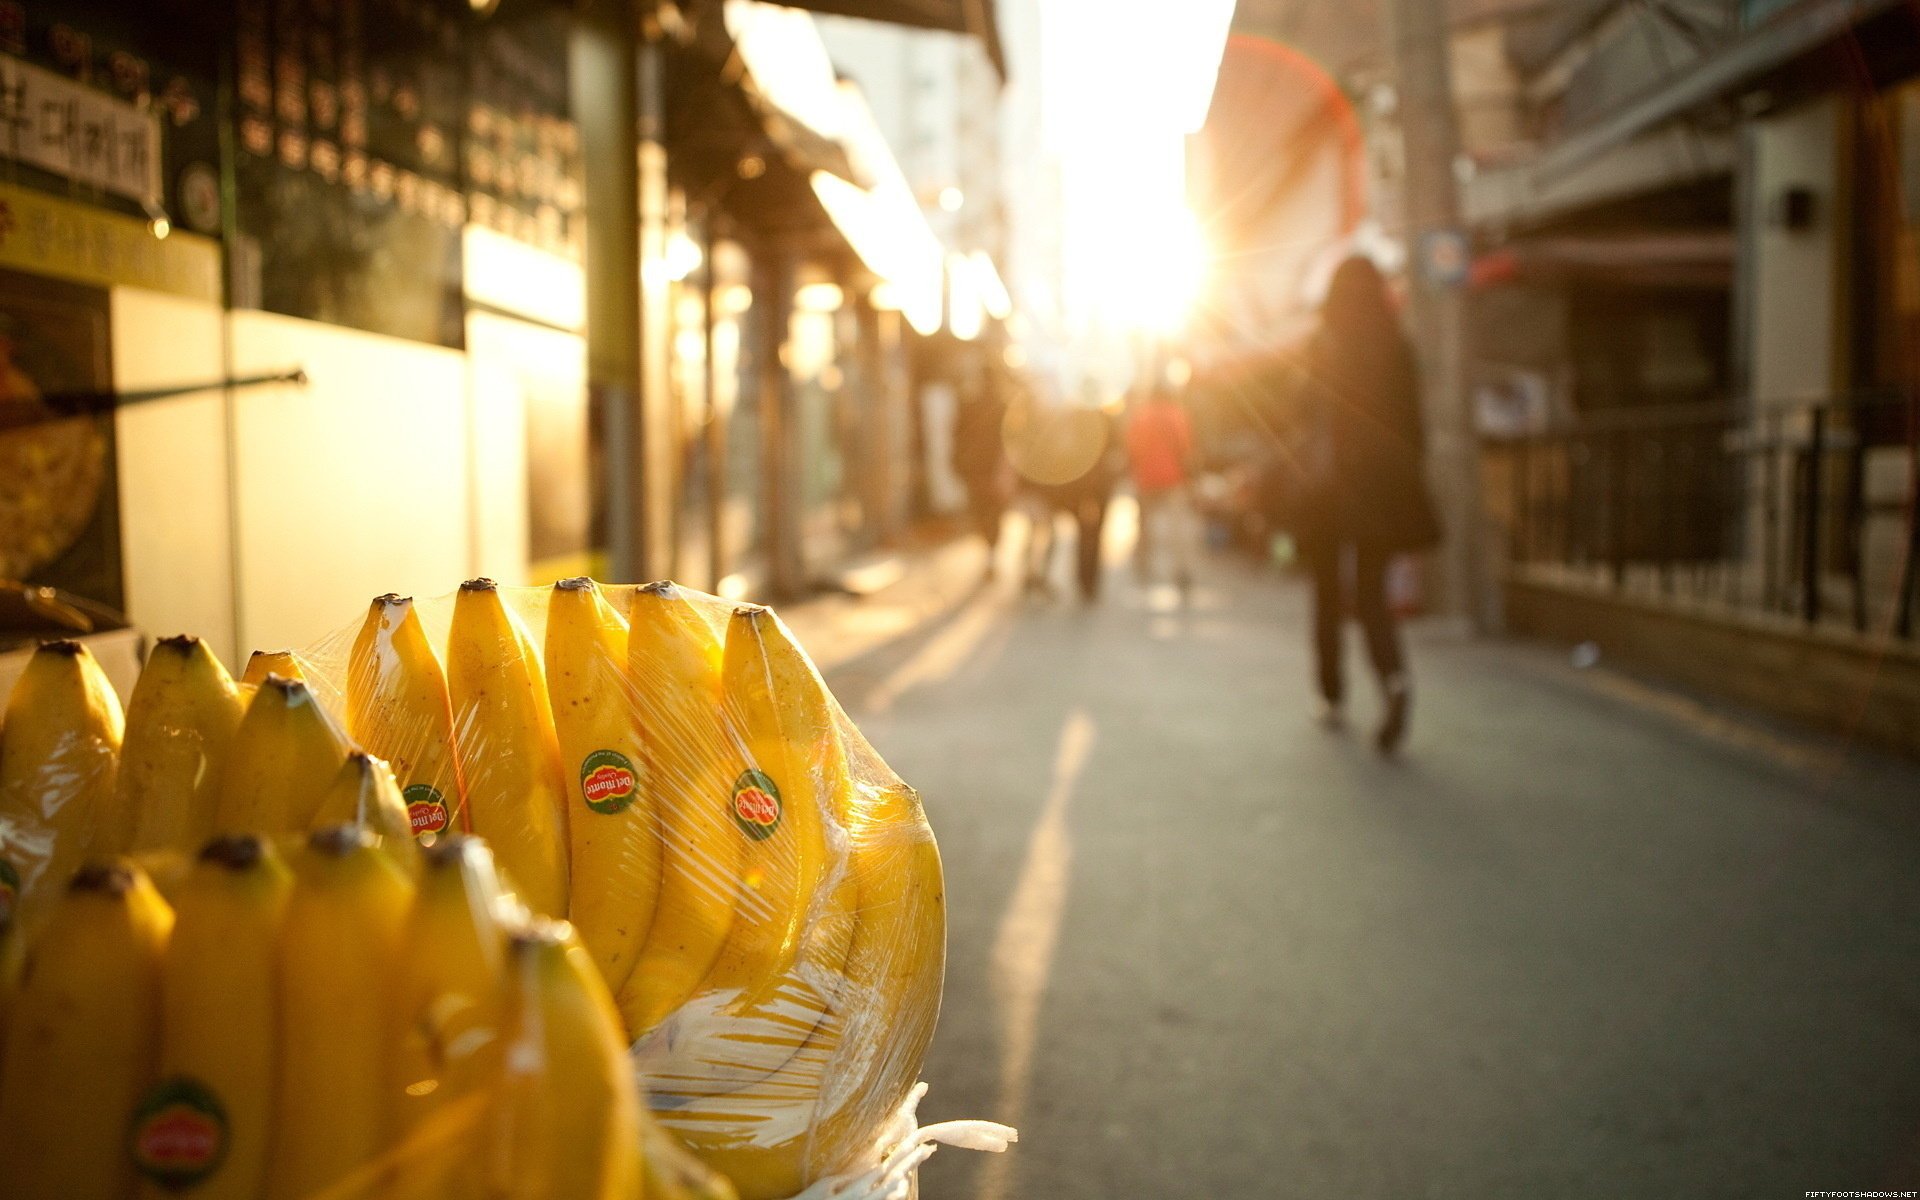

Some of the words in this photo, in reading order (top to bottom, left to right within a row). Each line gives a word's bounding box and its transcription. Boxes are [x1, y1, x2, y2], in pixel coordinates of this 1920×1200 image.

[586, 779, 616, 794] Monte
[616, 776, 630, 788] Del
[429, 811, 445, 823] Del
